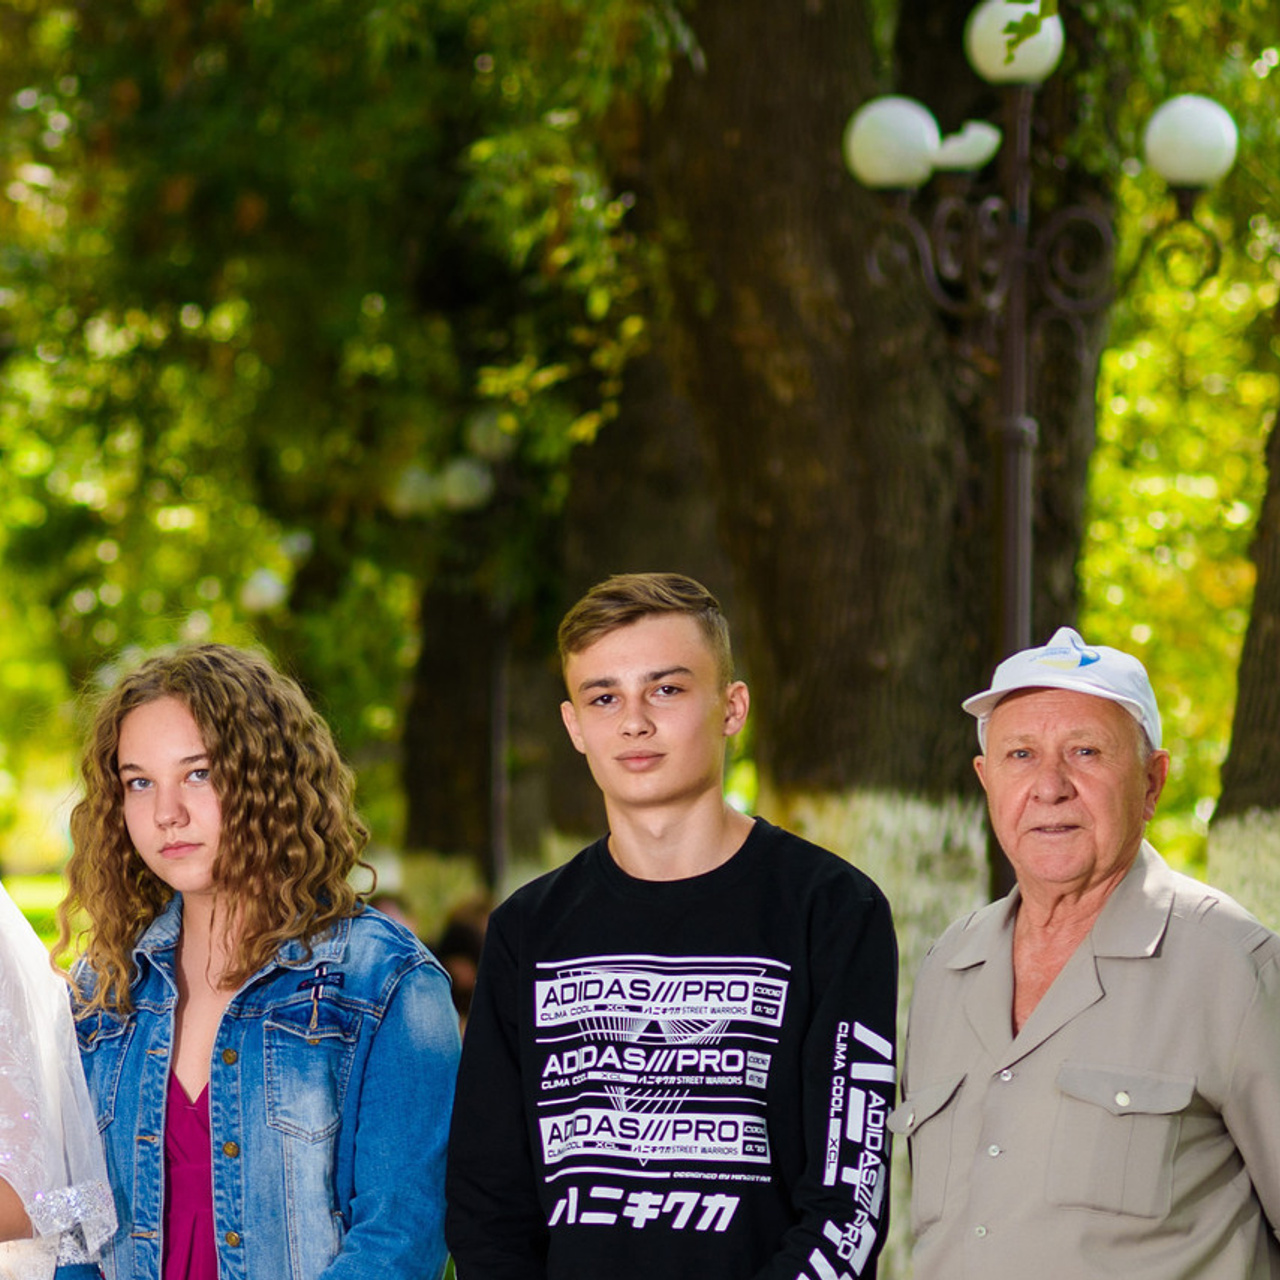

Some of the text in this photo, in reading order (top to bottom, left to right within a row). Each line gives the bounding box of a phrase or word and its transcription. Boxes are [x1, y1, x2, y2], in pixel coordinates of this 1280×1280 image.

[542, 978, 750, 1009] ADIDAS///PRO
[540, 1004, 593, 1021] CLIMA COOL
[682, 1006, 748, 1016] STREET WARRIORS
[829, 1021, 850, 1118] CLIMA COOL
[541, 1078, 570, 1090] CLIMA
[827, 1138, 838, 1170] XCL
